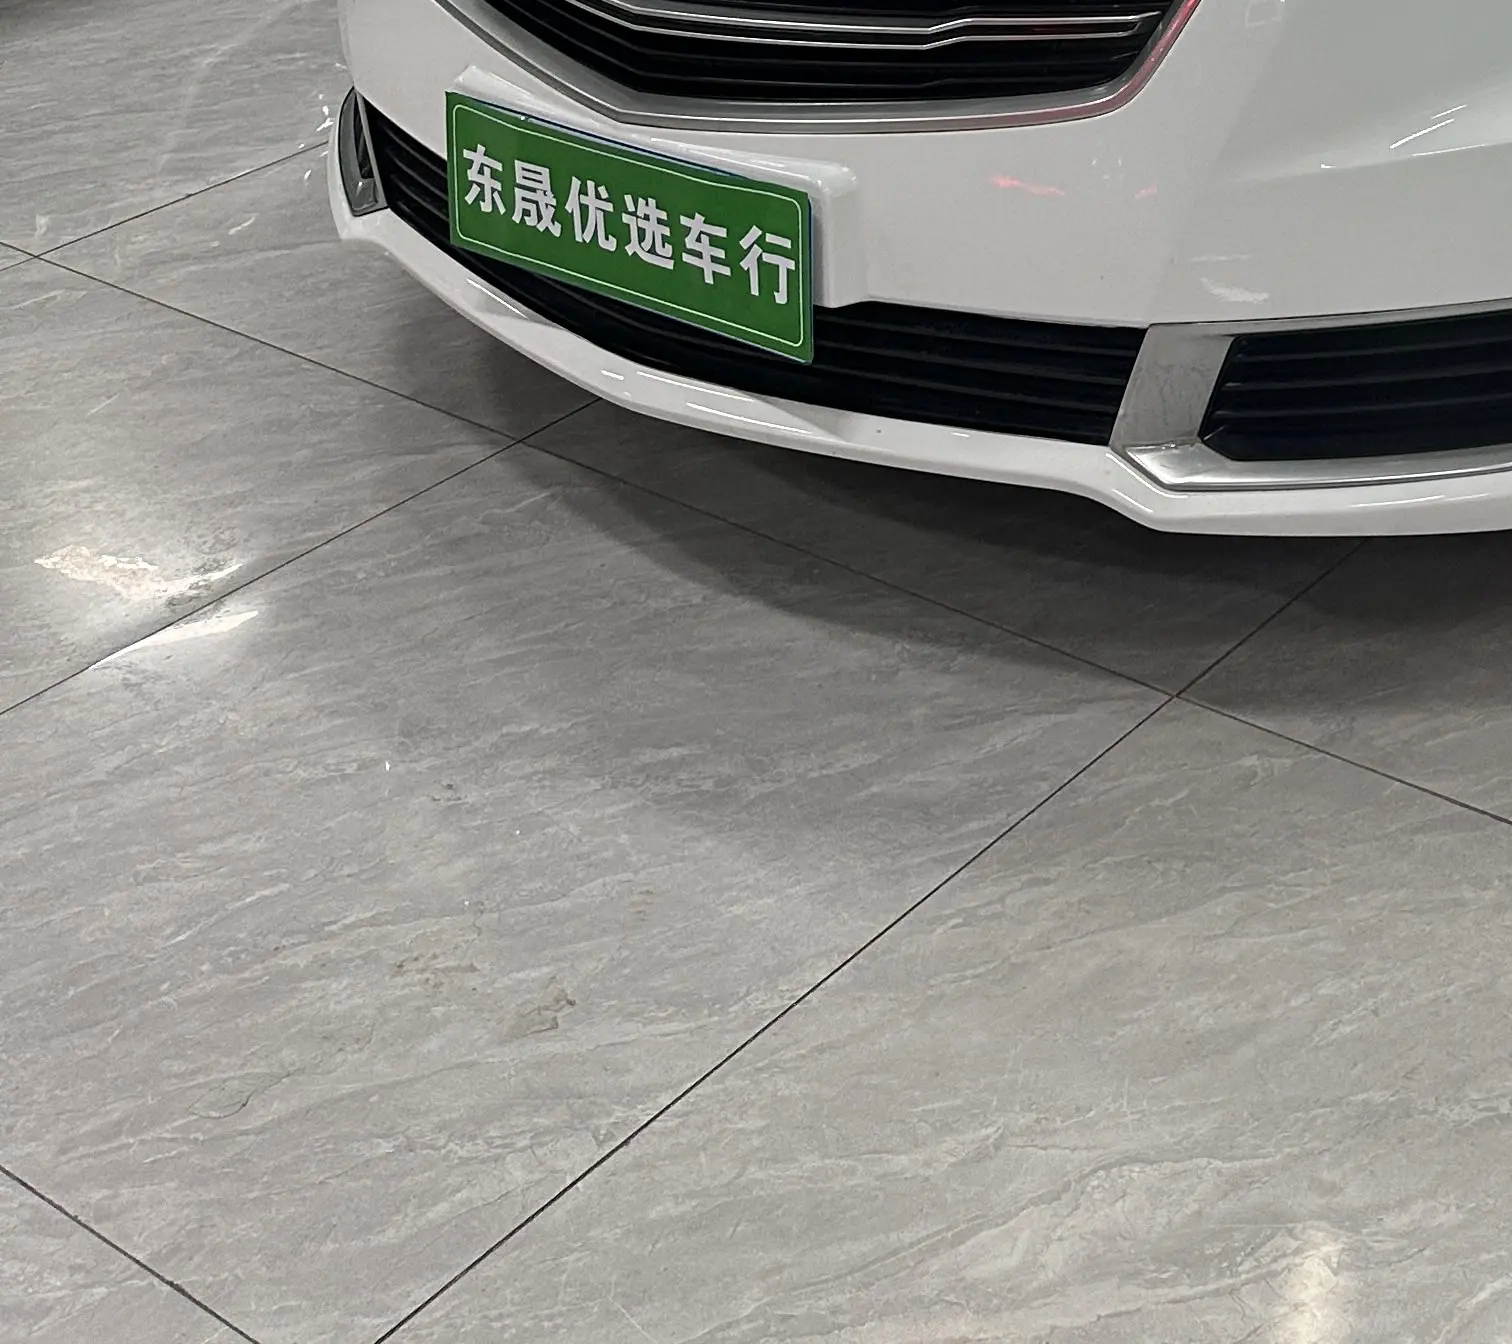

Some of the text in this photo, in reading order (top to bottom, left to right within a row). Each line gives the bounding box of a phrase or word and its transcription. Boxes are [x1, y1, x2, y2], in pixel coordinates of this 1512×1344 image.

[462, 143, 796, 305] 东晟优选车行
